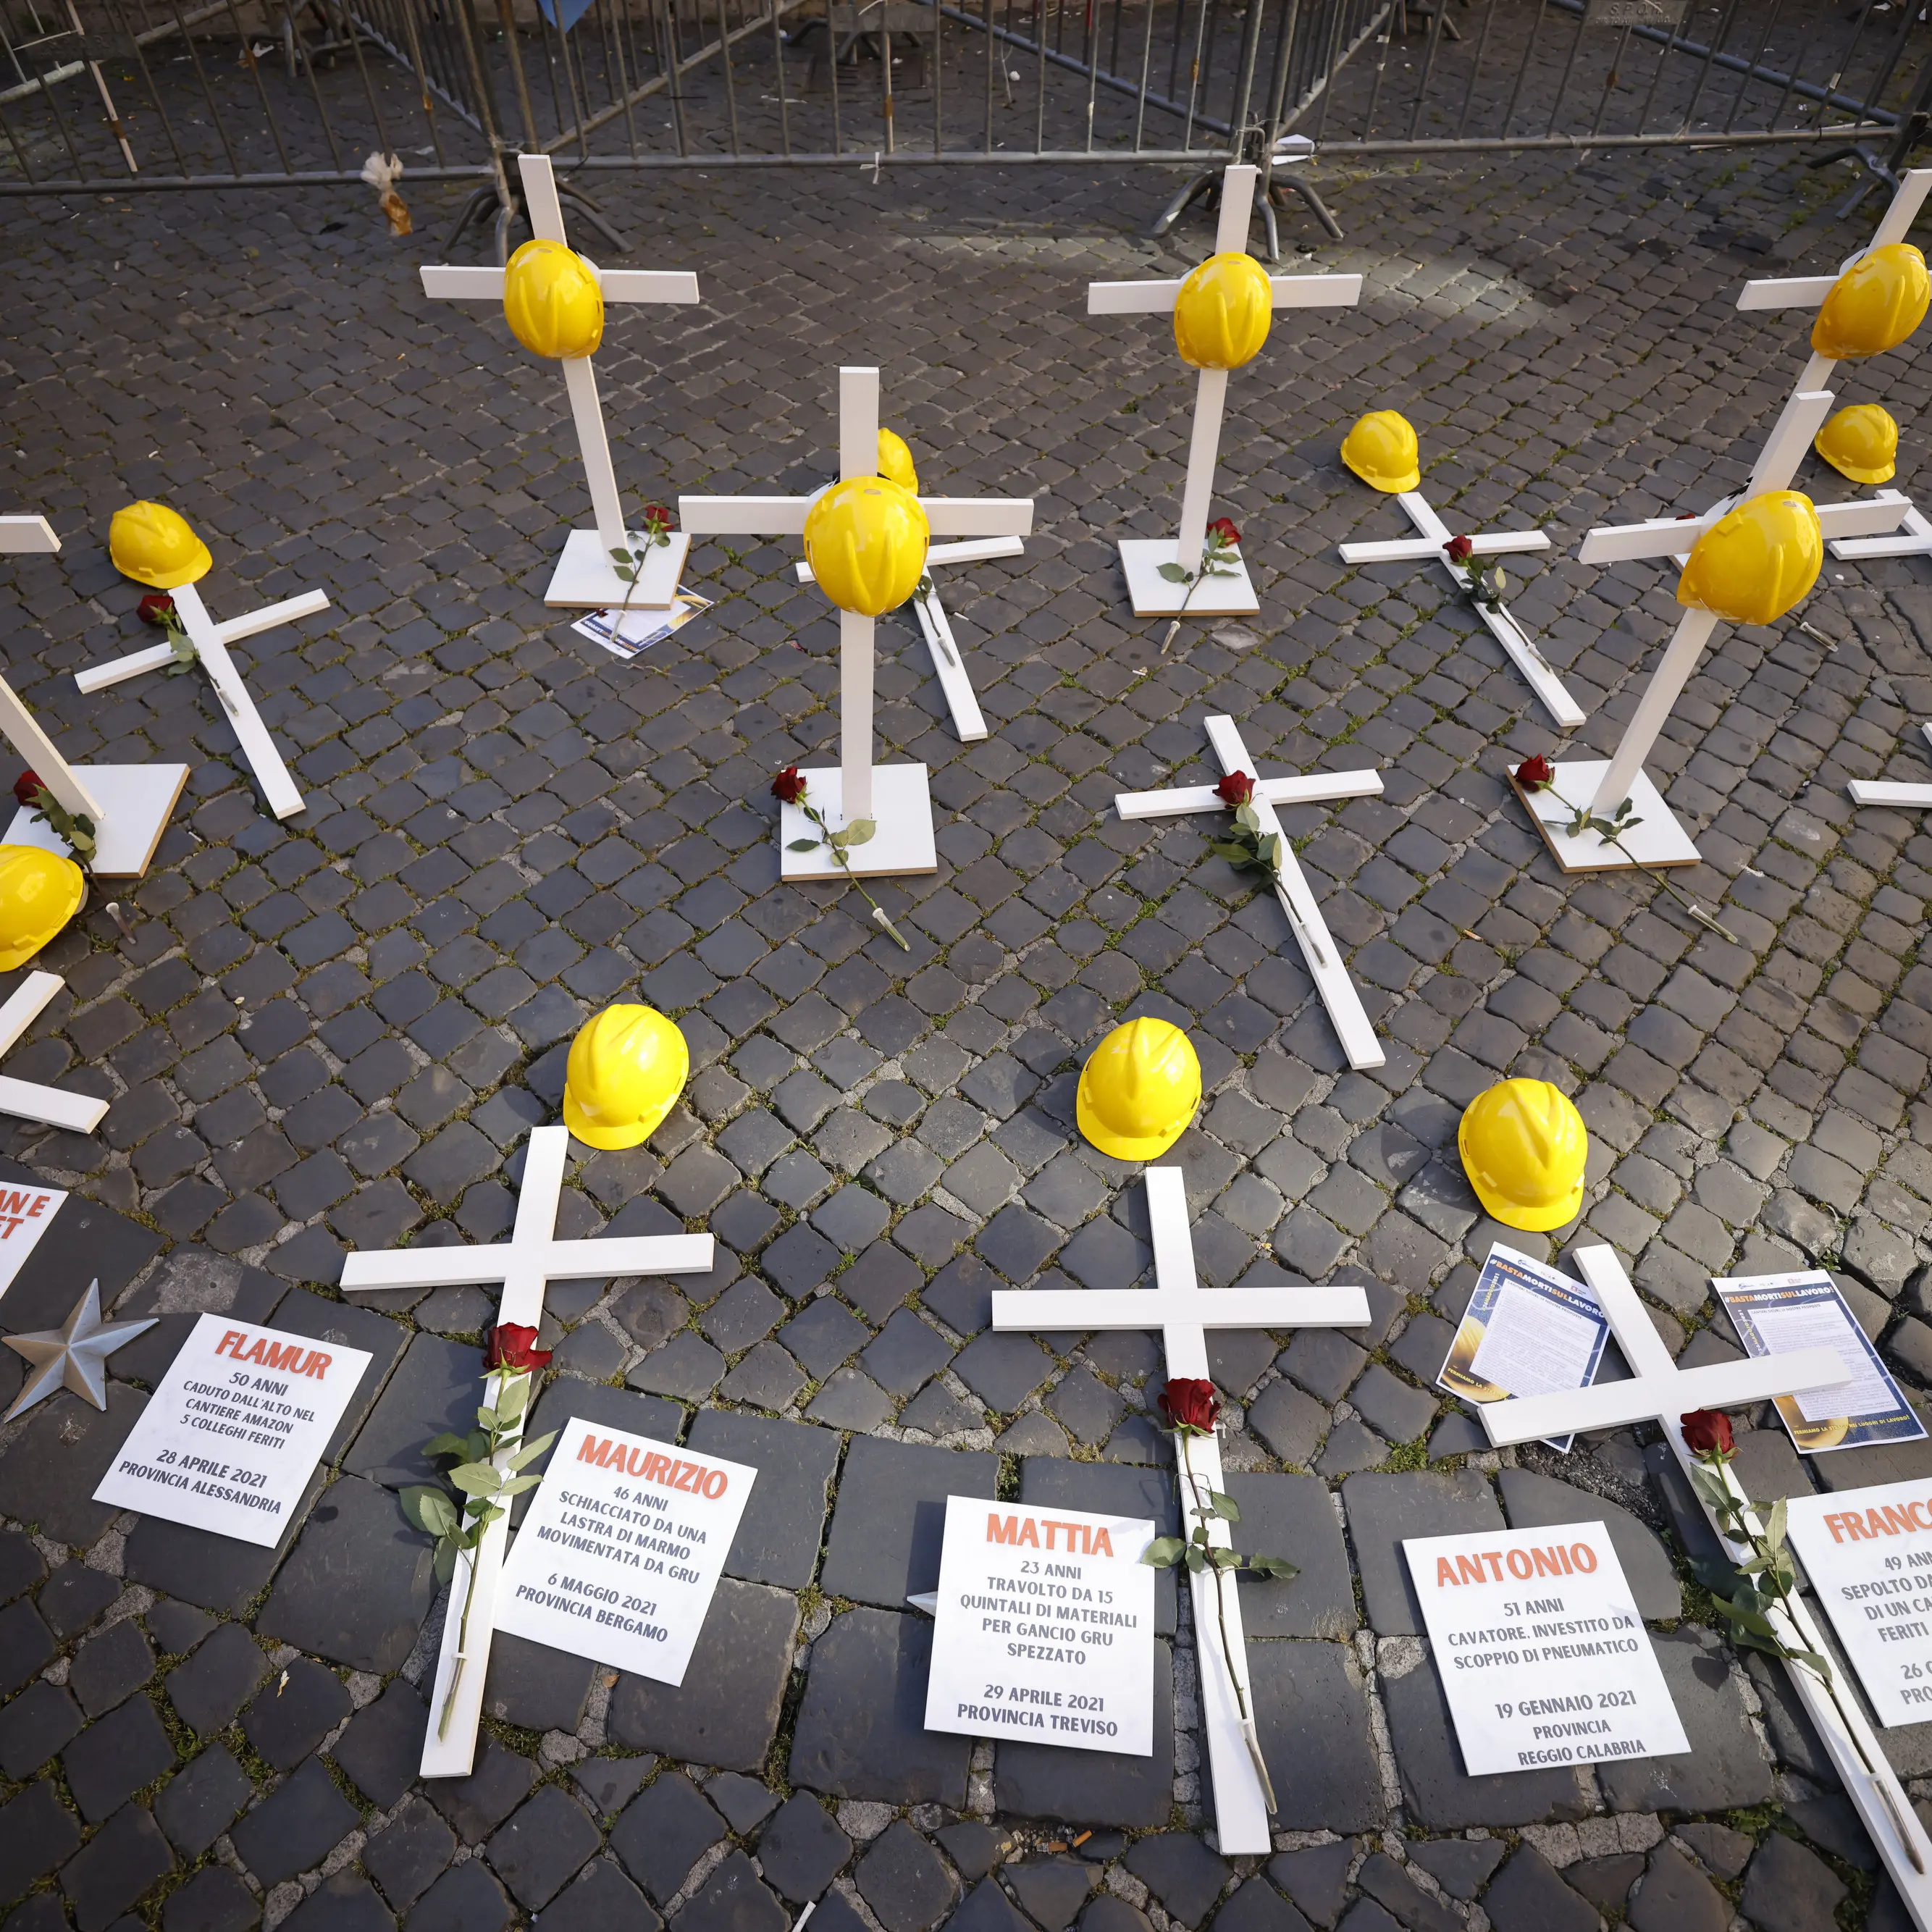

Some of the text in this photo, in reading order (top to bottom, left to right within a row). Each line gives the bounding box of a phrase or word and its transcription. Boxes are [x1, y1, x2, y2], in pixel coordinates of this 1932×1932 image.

[26, 1195, 51, 1218] E
[1724, 1286, 1834, 1303] #BASTAMORTISULLAVORO!
[215, 1330, 332, 1380] FLAMUR
[229, 1372, 289, 1396] 50 ANNI
[1448, 1367, 1474, 1384] FERMIAMO
[183, 1381, 314, 1422] CADUTO DALL'ALTO NEL
[186, 1398, 294, 1434] CANTIERE AMAZON
[180, 1414, 285, 1449] 5 COLLEGHI FERITI
[156, 1450, 267, 1488] 28 APRILE 2021
[576, 1435, 728, 1500] MAURIZIO
[119, 1461, 281, 1514] PROVINCIA ALESSANDRIA
[613, 1487, 668, 1511] 46 ANNI
[559, 1491, 706, 1544] SCHIACCIATO DA UNA
[1823, 1498, 1932, 1543] FRANC
[560, 1512, 690, 1560] LASTRA DI MARMO
[986, 1513, 1114, 1557] MATTIA
[537, 1526, 700, 1584] MOVIMENTATA DA GRU
[1437, 1543, 1597, 1587] ANTONIO
[1885, 1556, 1902, 1571] 49
[1021, 1561, 1081, 1579] 23 ANNI
[547, 1574, 657, 1616] 6 MAGGIO 2021
[988, 1576, 1112, 1603] TRAVOLTO DA 15
[1841, 1578, 1912, 1600] SEPOLTO
[516, 1584, 668, 1642] PROVINCIA BERGAMO
[961, 1595, 1136, 1628] QUINTALI DI MATERIALI
[1503, 1598, 1564, 1616] 51 ANNI
[1864, 1597, 1932, 1620] DI UN CA
[983, 1618, 1113, 1646] PER GANCIO GRU
[1532, 1618, 1609, 1638] INVESTITO
[1612, 1616, 1634, 1629] DA
[1877, 1622, 1929, 1642] FERITI
[1007, 1643, 1085, 1665] SPEZZATO
[1454, 1639, 1638, 1669] SCOPPIO DI PNEUMATICO
[1900, 1663, 1923, 1679] 26
[984, 1684, 1104, 1712] 29 APRILE 2021
[1495, 1690, 1637, 1718] 19 GENNAIO 2021
[1900, 1686, 1932, 1705] PRO
[957, 1703, 1117, 1736] PROVINCIA TREVISO
[1533, 1720, 1612, 1739] PROVINCIA
[1518, 1739, 1647, 1765] REGGIO CALABRIA
